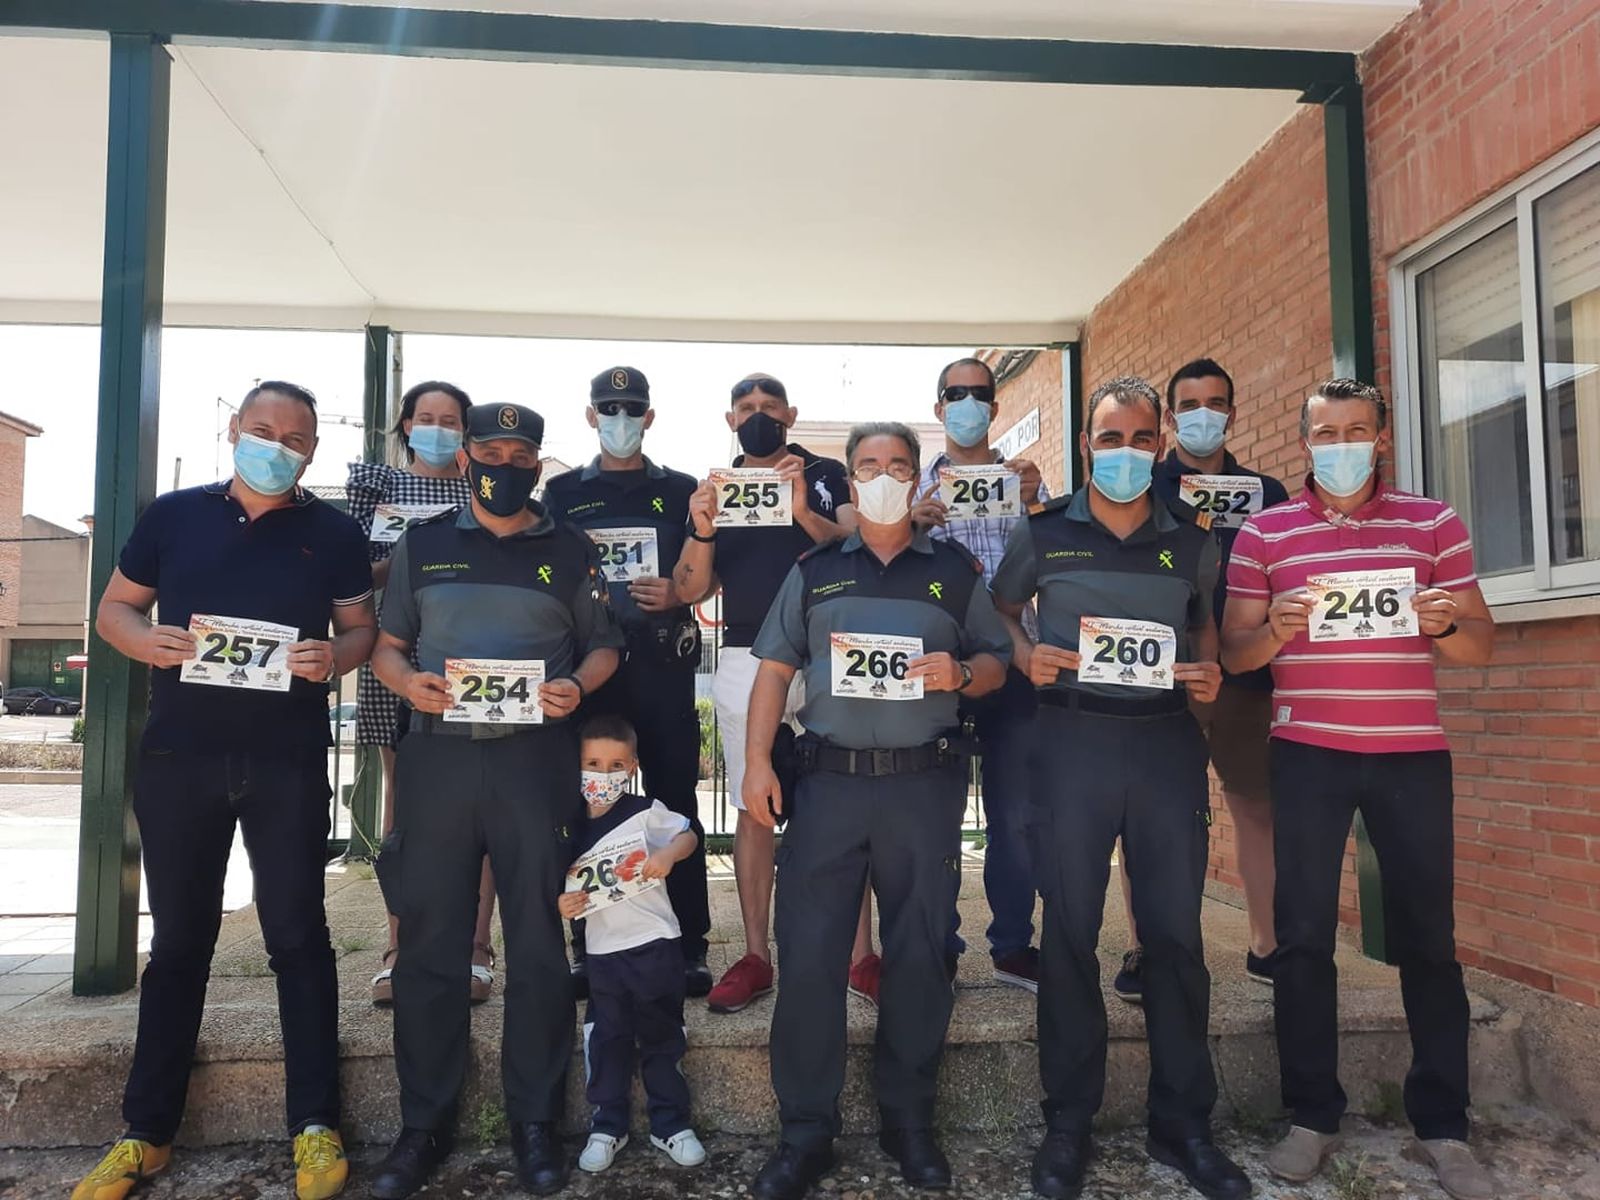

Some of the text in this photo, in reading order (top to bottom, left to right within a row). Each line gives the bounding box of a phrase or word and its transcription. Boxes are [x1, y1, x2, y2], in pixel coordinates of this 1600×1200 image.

[1018, 414, 1038, 447] POR
[723, 483, 779, 508] 255
[953, 477, 1004, 503] 261
[1193, 490, 1251, 514] 252
[596, 541, 643, 566] 251
[1045, 551, 1075, 559] GUARDIA
[812, 582, 840, 594] GUARDIA
[1324, 588, 1399, 620] 246
[201, 633, 280, 668] 257
[1093, 635, 1161, 667] 260
[846, 649, 909, 680] 266
[460, 675, 530, 703] 254
